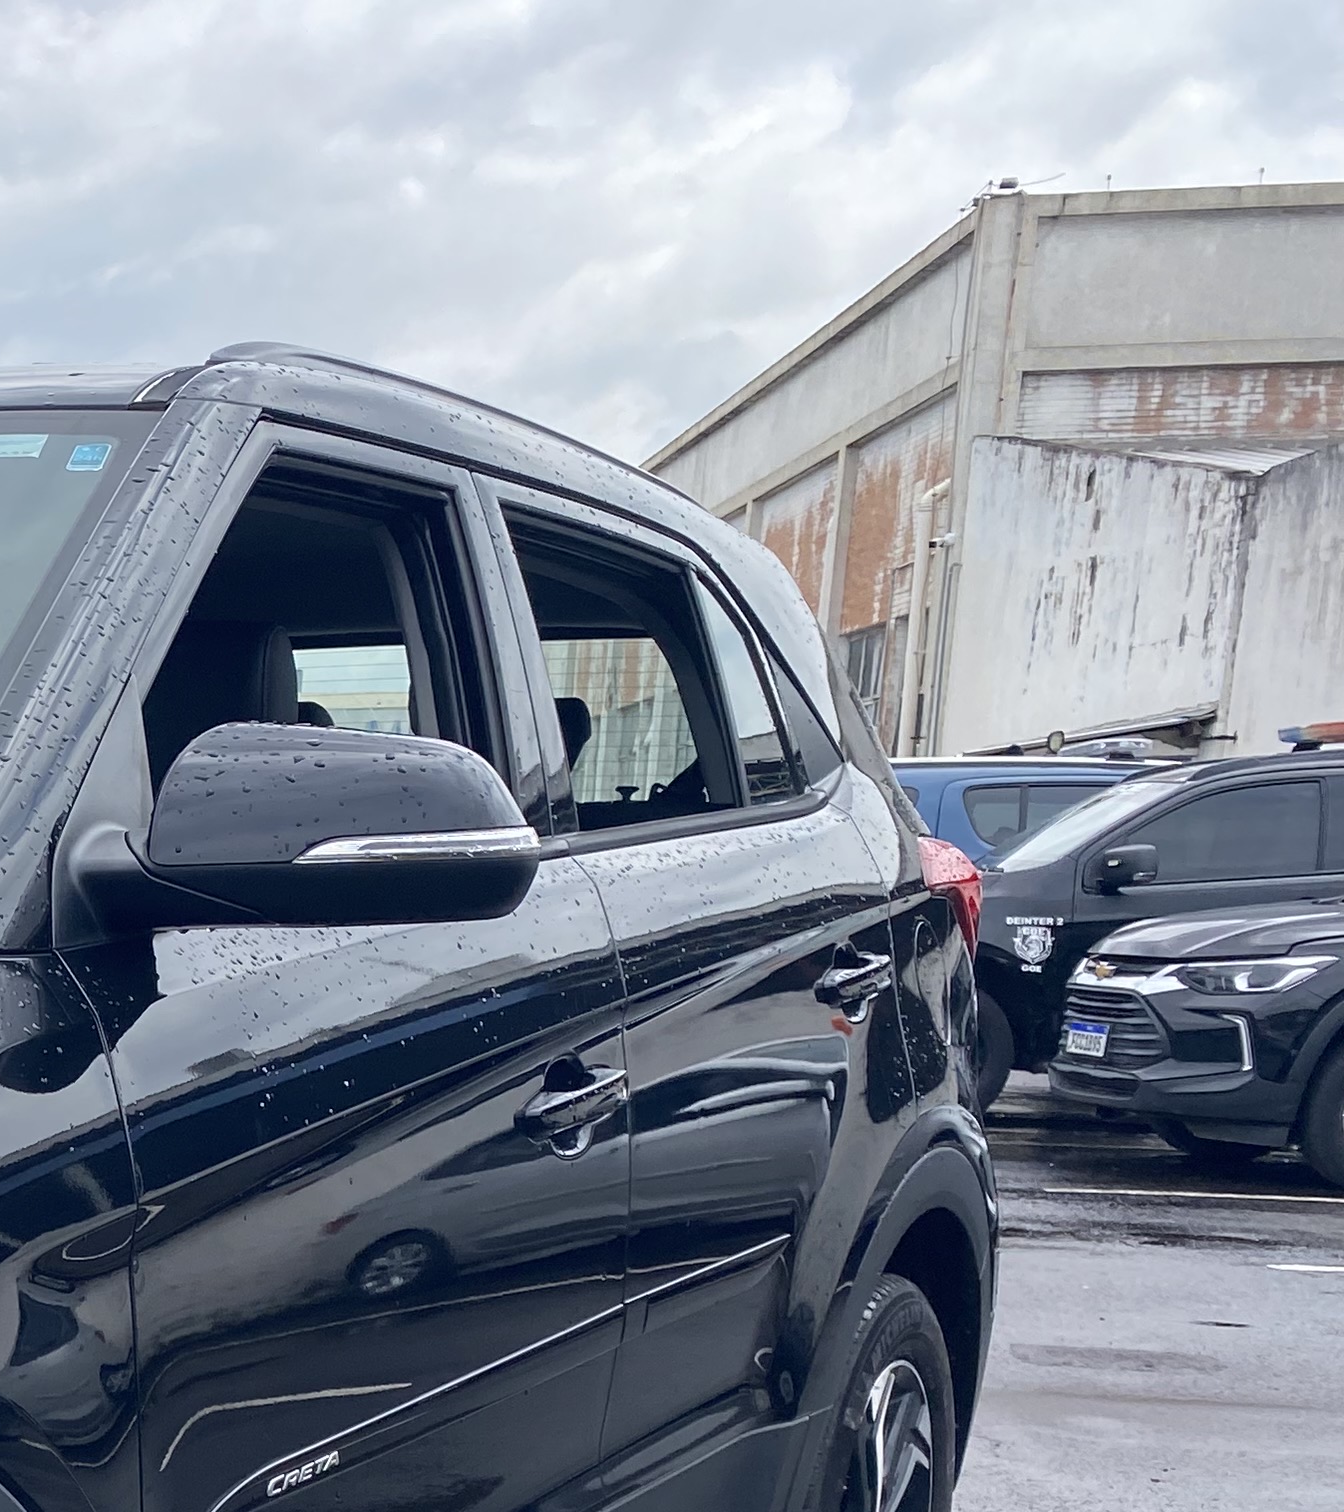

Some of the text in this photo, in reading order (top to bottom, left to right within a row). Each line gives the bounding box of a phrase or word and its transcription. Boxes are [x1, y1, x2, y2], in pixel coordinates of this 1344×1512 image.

[1006, 916, 1064, 926] DEINTER 2
[267, 1450, 340, 1497] CRETA
